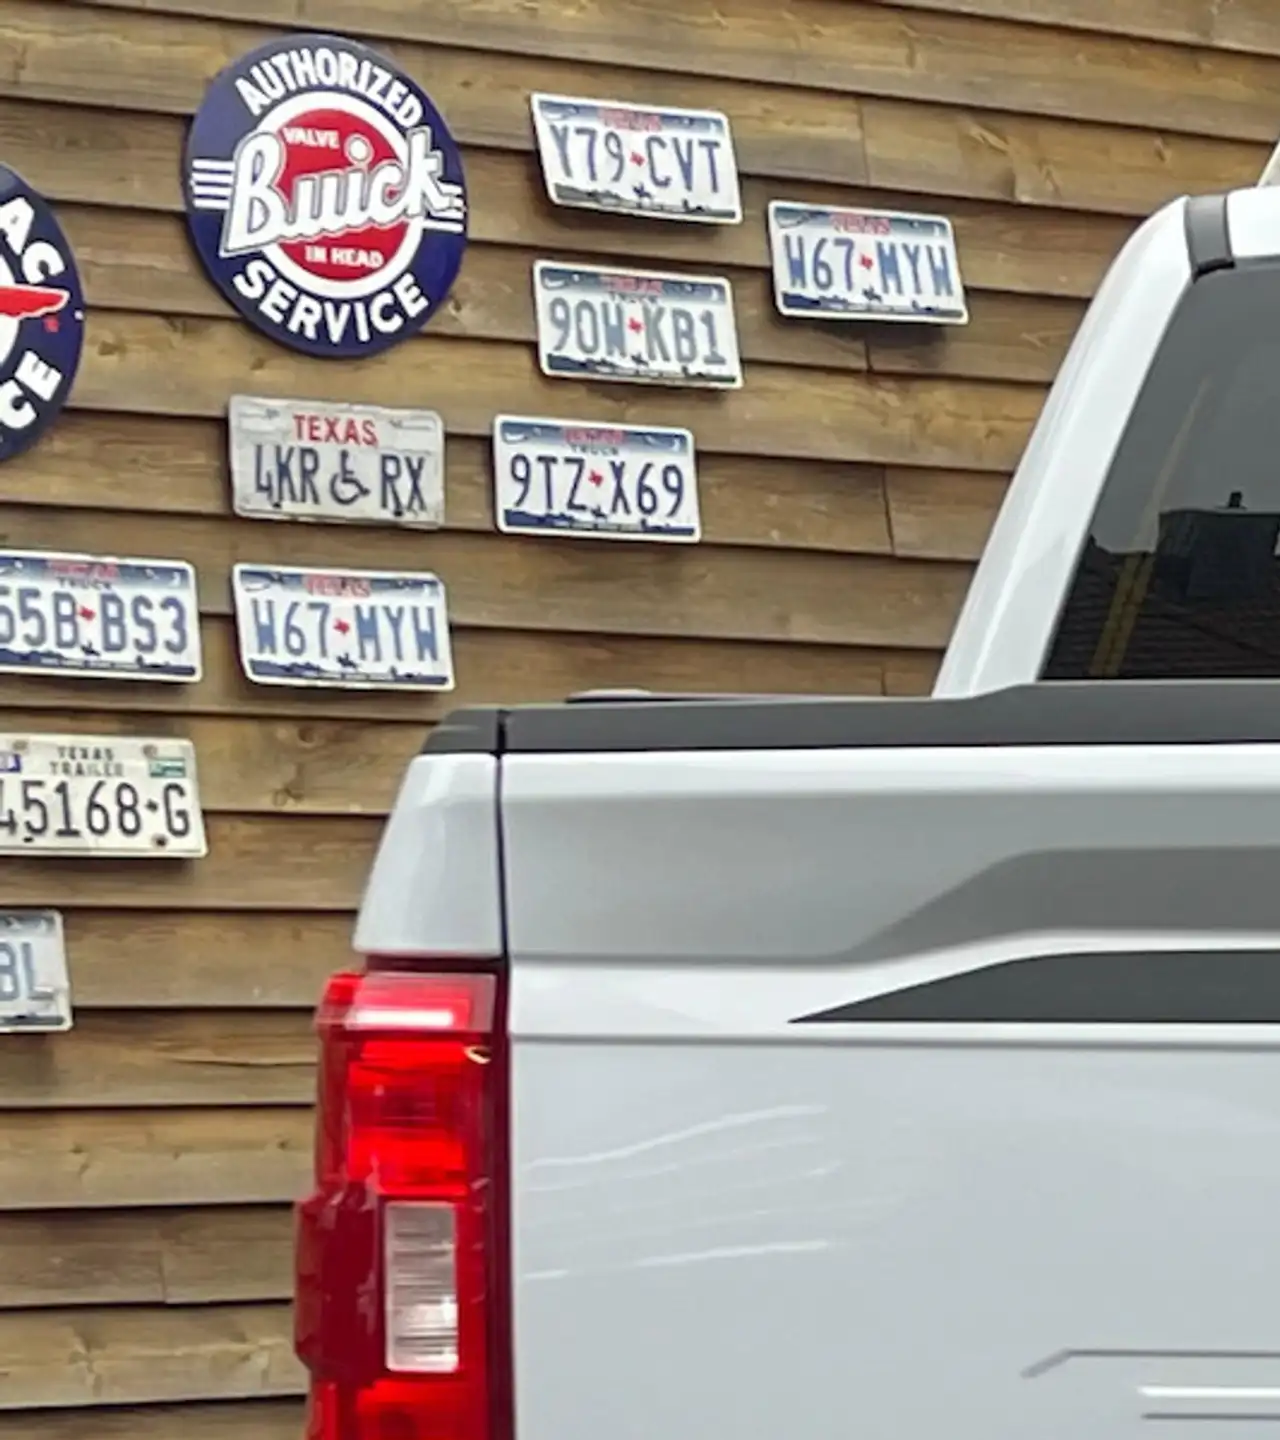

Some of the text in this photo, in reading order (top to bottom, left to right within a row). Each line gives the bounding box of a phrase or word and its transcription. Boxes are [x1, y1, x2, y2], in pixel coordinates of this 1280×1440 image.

[235, 47, 424, 128] AUTHORIZED
[283, 127, 340, 149] VALVE
[550, 124, 720, 194] Y79 CVT
[219, 126, 448, 258] Buick
[304, 247, 384, 268] IN HEAD
[784, 234, 953, 296] W67 MYW
[232, 259, 430, 344] SERVICE
[642, 301, 728, 366] KB1
[292, 414, 379, 447] TEXAS
[255, 443, 428, 513] 4KR RX
[510, 453, 685, 518] 9TZ X69
[99, 593, 188, 655] BS3
[251, 598, 439, 662] W67 MYW
[49, 761, 125, 778] TRAILER
[57, 746, 115, 761] TEXAS
